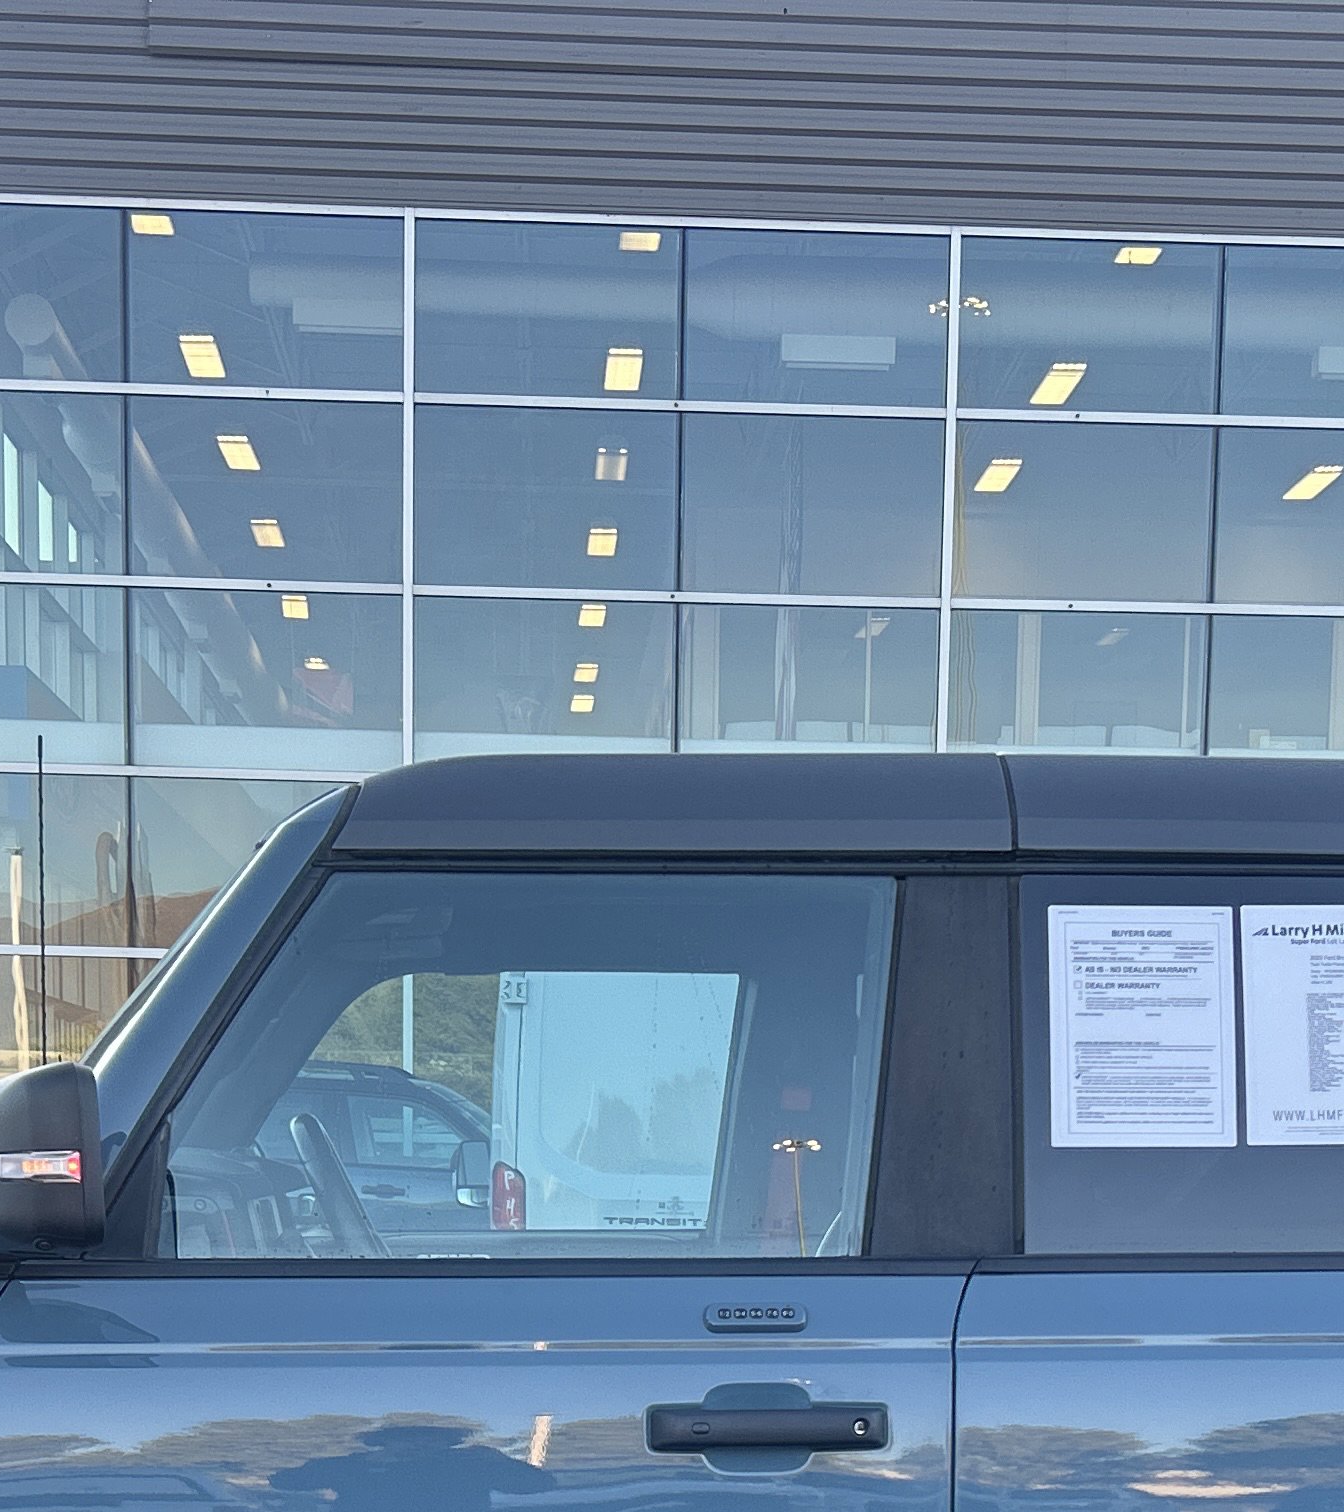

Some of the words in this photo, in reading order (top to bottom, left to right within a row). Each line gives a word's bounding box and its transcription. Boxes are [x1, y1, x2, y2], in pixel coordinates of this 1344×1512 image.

[1111, 930, 1145, 938] BUYERS
[1147, 930, 1173, 938] GUIDE
[1271, 924, 1310, 938] Larry
[1312, 924, 1322, 936] H
[1123, 966, 1154, 974] DEALER
[1154, 966, 1198, 974] WARRANTY
[1084, 982, 1116, 990] DEALER
[1117, 982, 1161, 990] WARRANTY
[602, 1216, 703, 1227] TRANSIT
